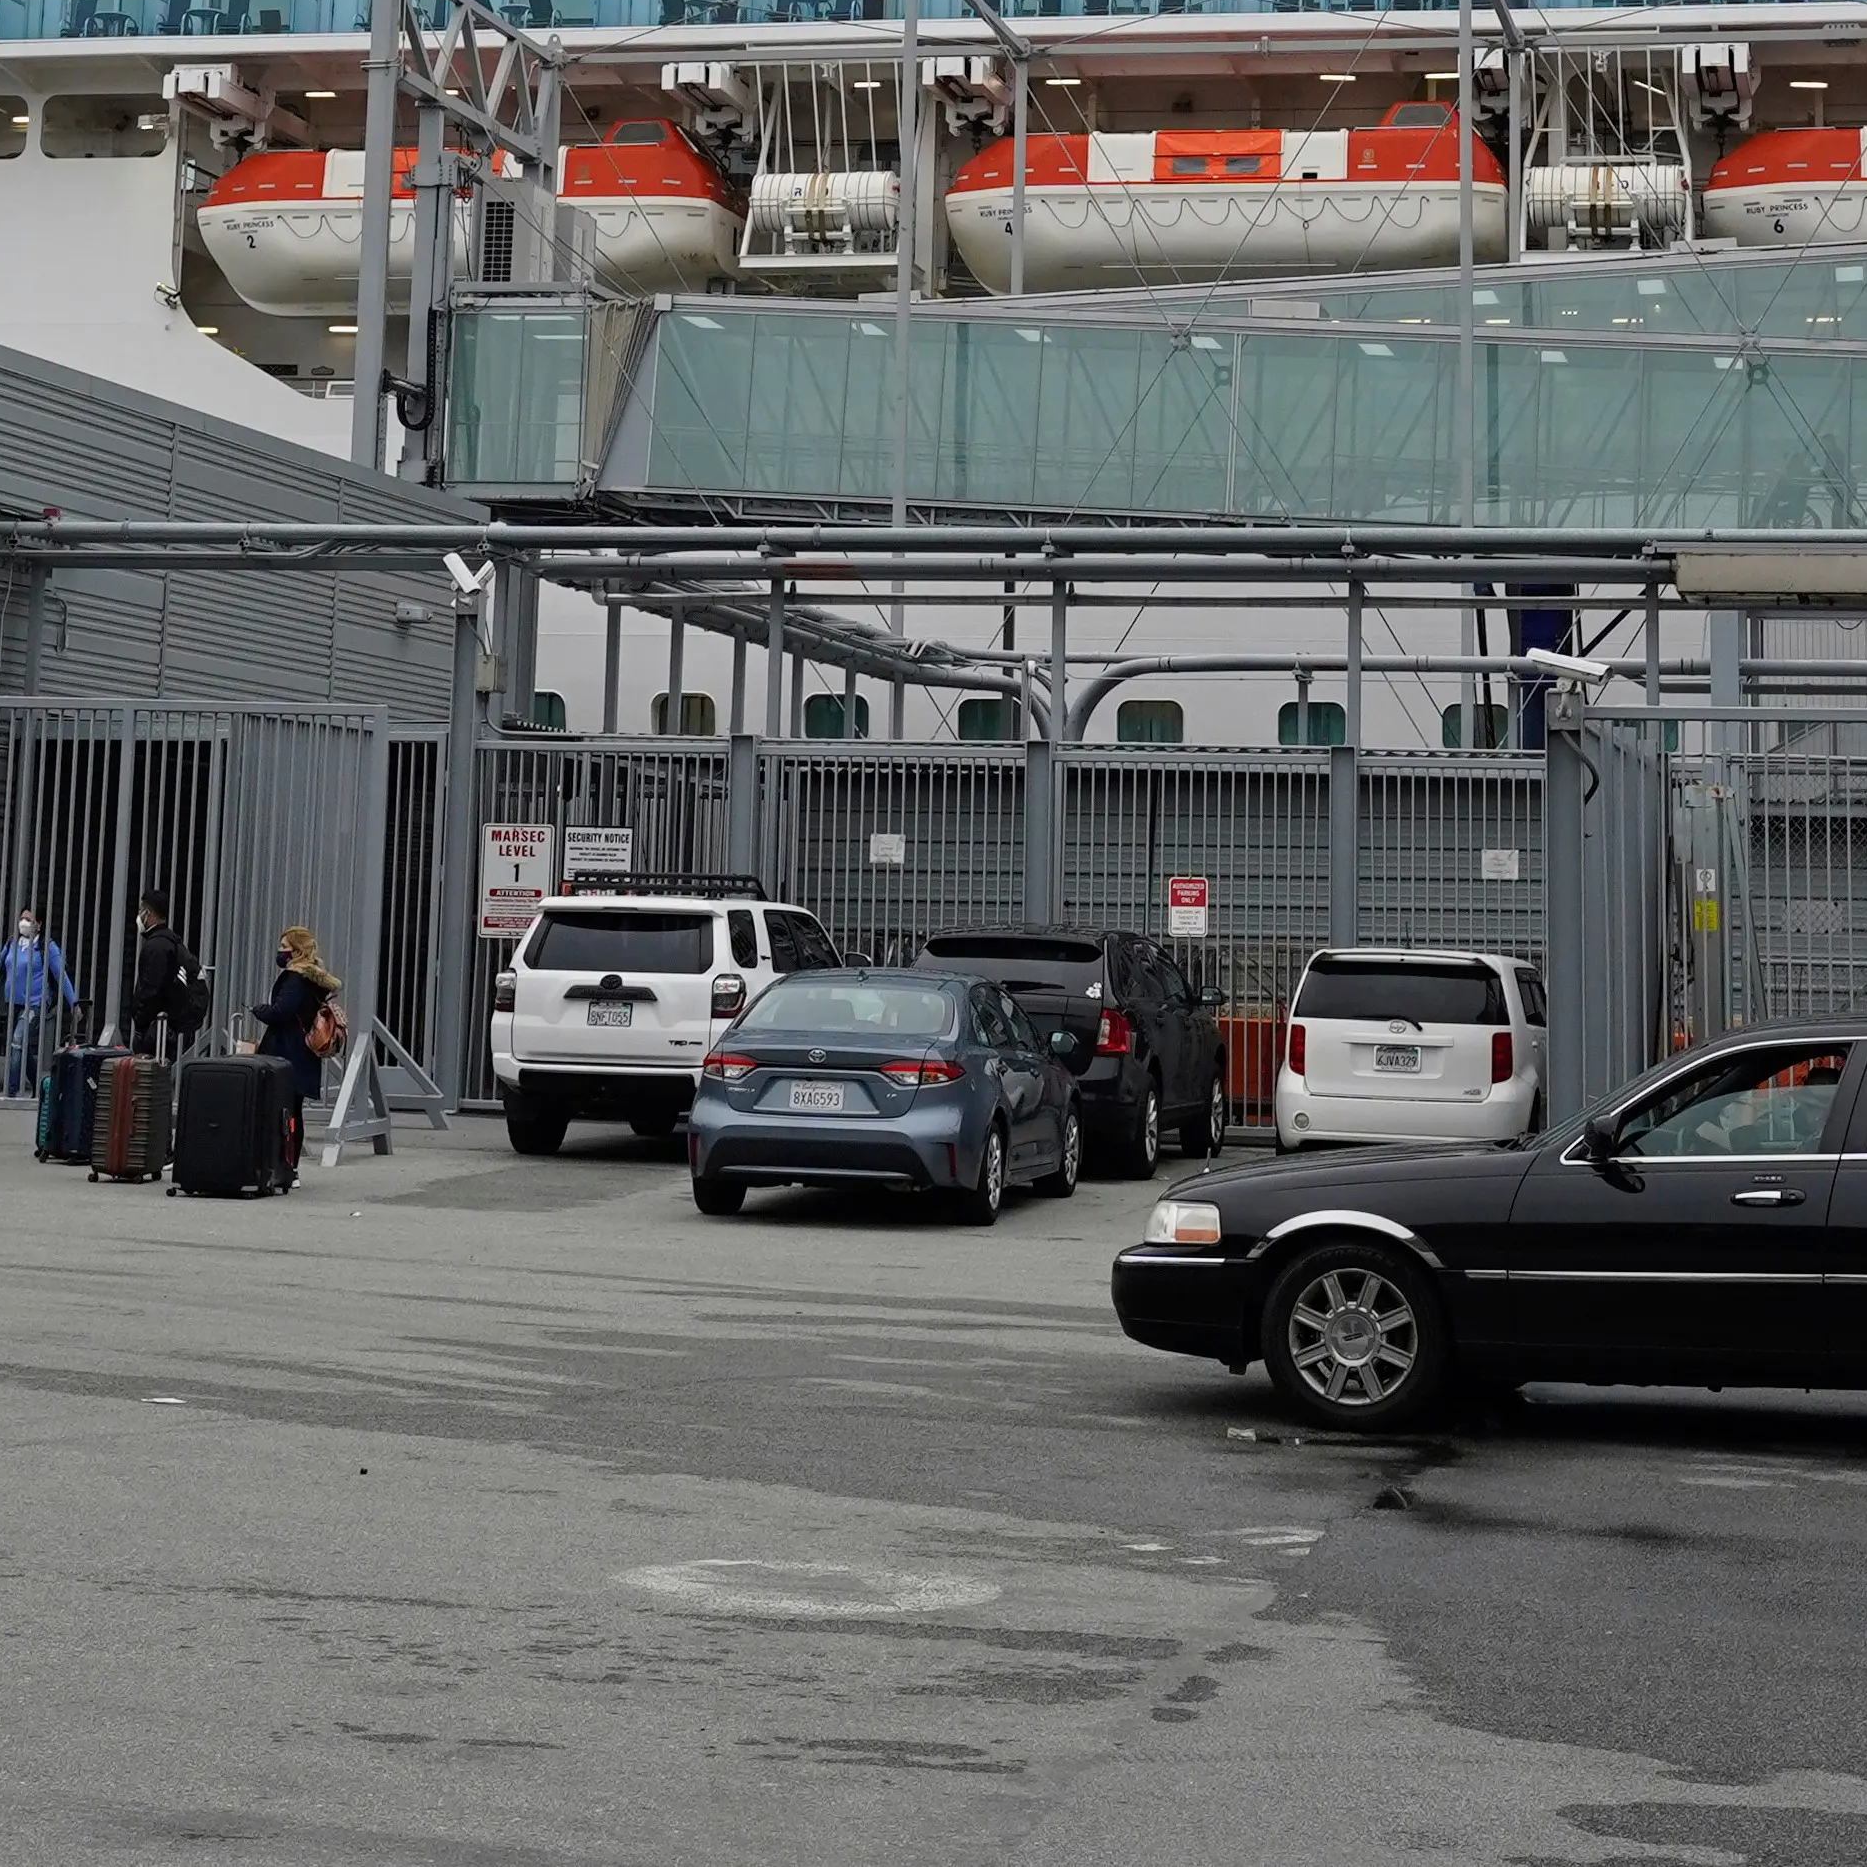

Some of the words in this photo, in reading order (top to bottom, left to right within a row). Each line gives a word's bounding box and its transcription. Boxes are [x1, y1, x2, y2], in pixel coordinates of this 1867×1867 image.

[998, 206, 1033, 216] PRINSS
[1745, 206, 1766, 215] RUBY
[1769, 202, 1809, 212] PRINCESS
[1004, 221, 1014, 236] 4
[1773, 218, 1785, 234] 6
[246, 234, 257, 249] 2
[491, 830, 545, 843] MARSEC
[567, 832, 602, 843] SECURITY
[604, 833, 630, 844] NOTICE
[499, 844, 536, 858] LEVEL
[513, 863, 520, 883] 1
[1377, 1055, 1418, 1067] 6JVA329
[793, 1091, 840, 1106] 8XAG593
